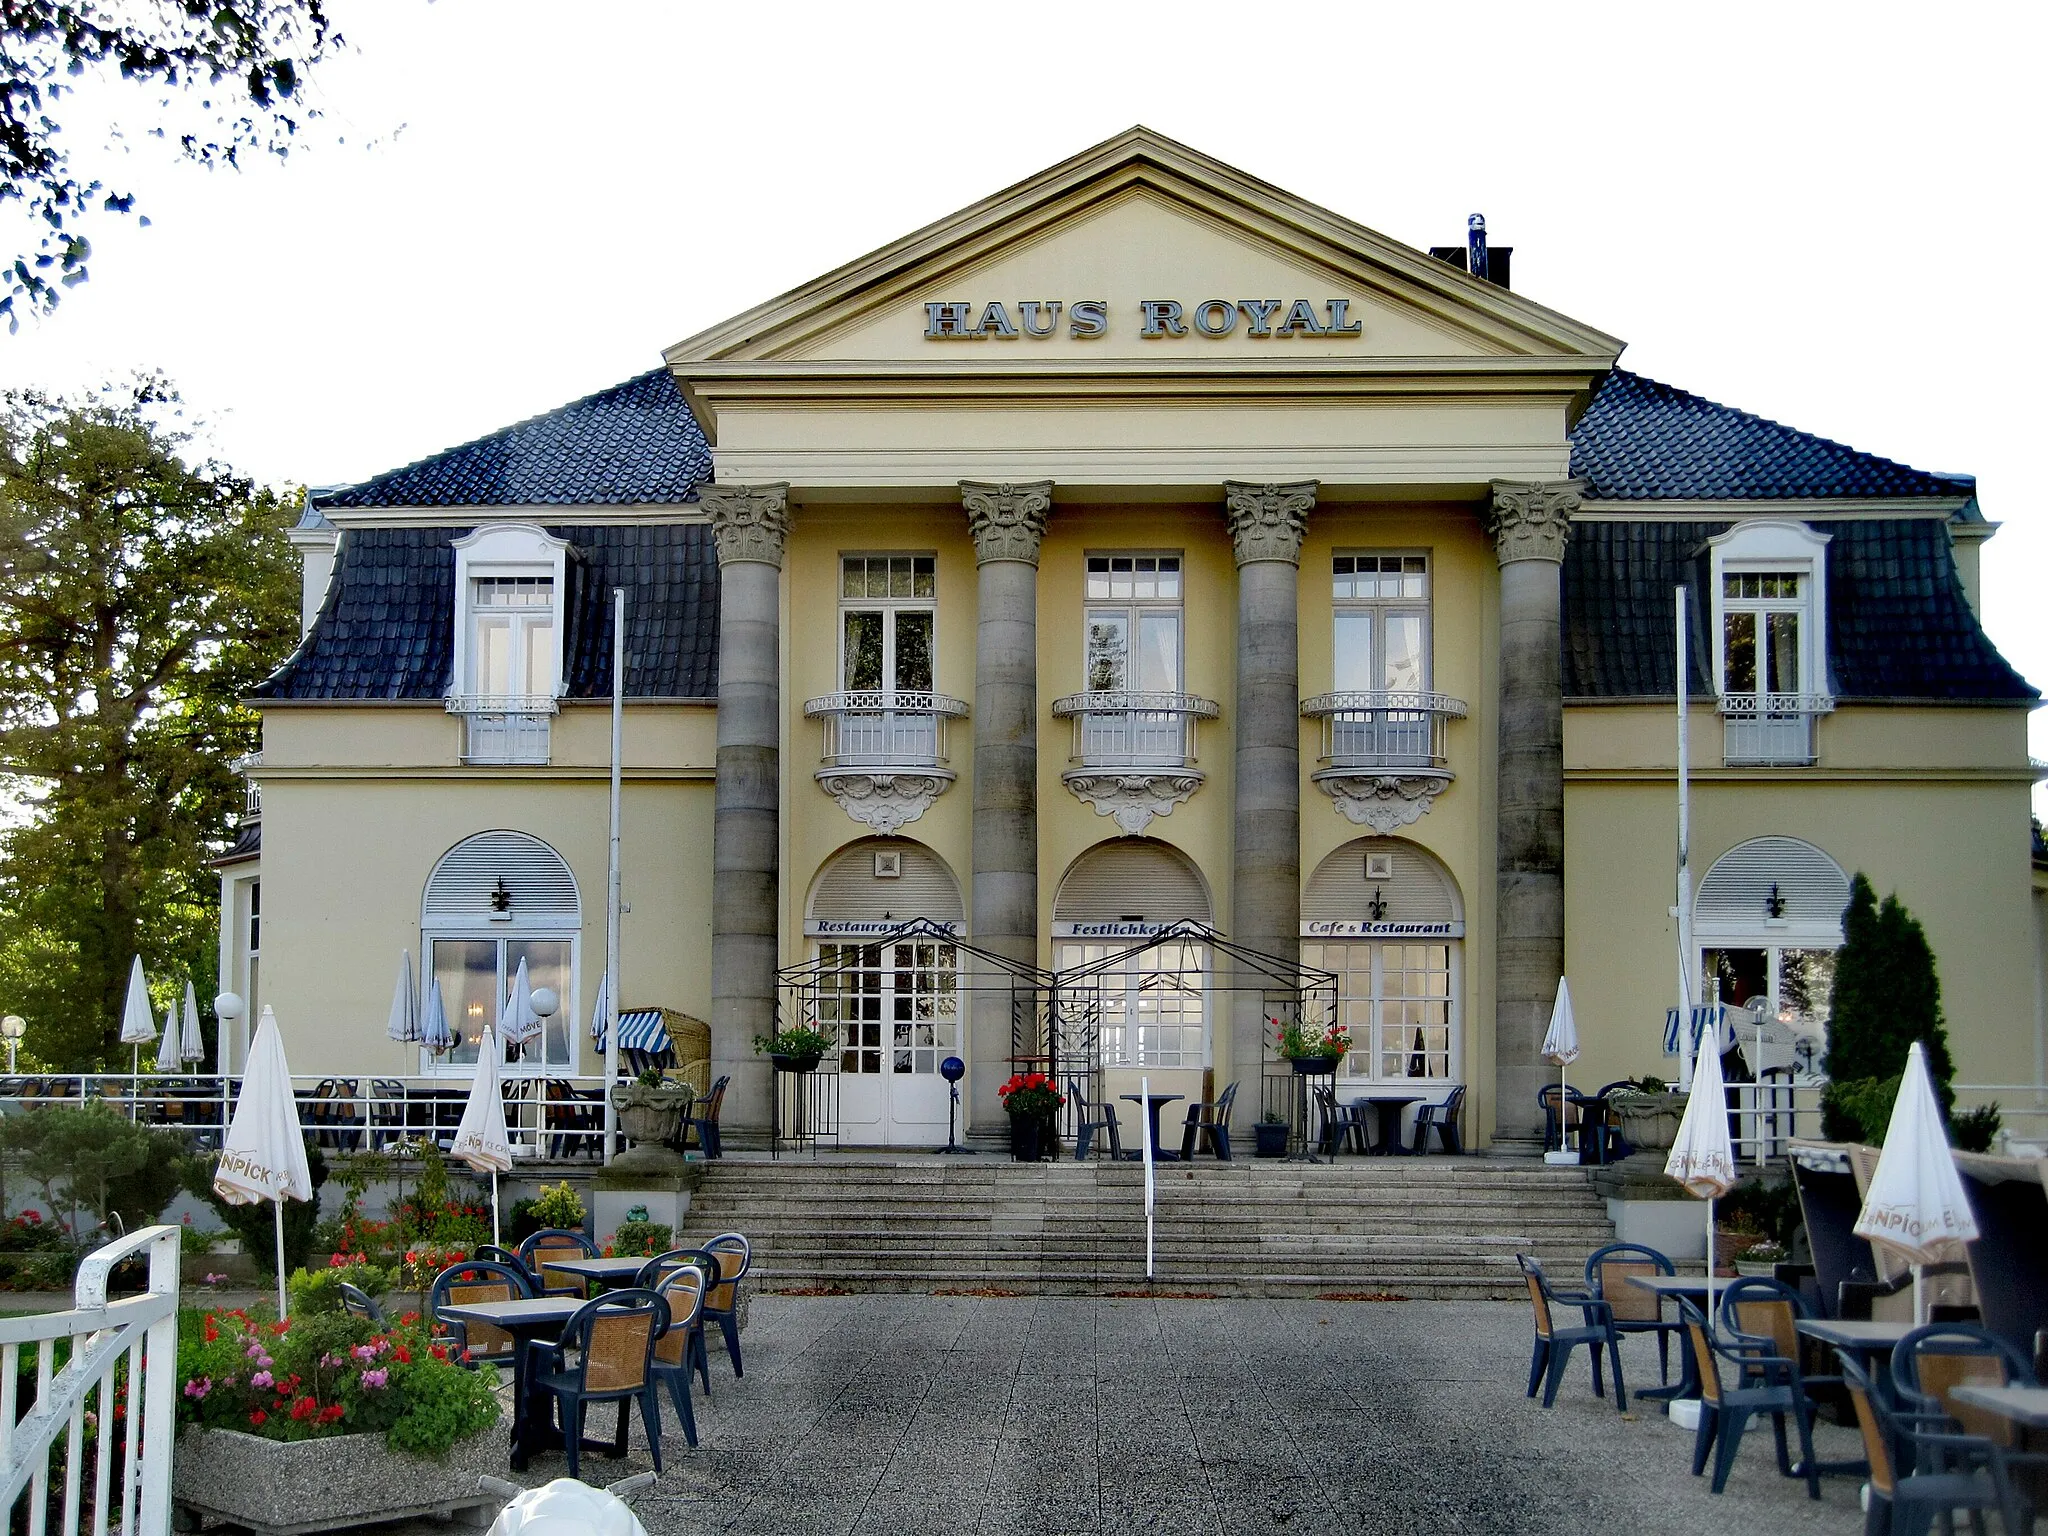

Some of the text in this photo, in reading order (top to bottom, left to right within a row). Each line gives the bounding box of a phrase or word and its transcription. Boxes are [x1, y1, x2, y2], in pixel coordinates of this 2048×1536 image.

[923, 299, 1362, 340] HAUS ROYAL
[1072, 923, 1190, 935] Festlichkeie
[1308, 921, 1344, 936] Cafe
[1361, 922, 1451, 934] Restaurant
